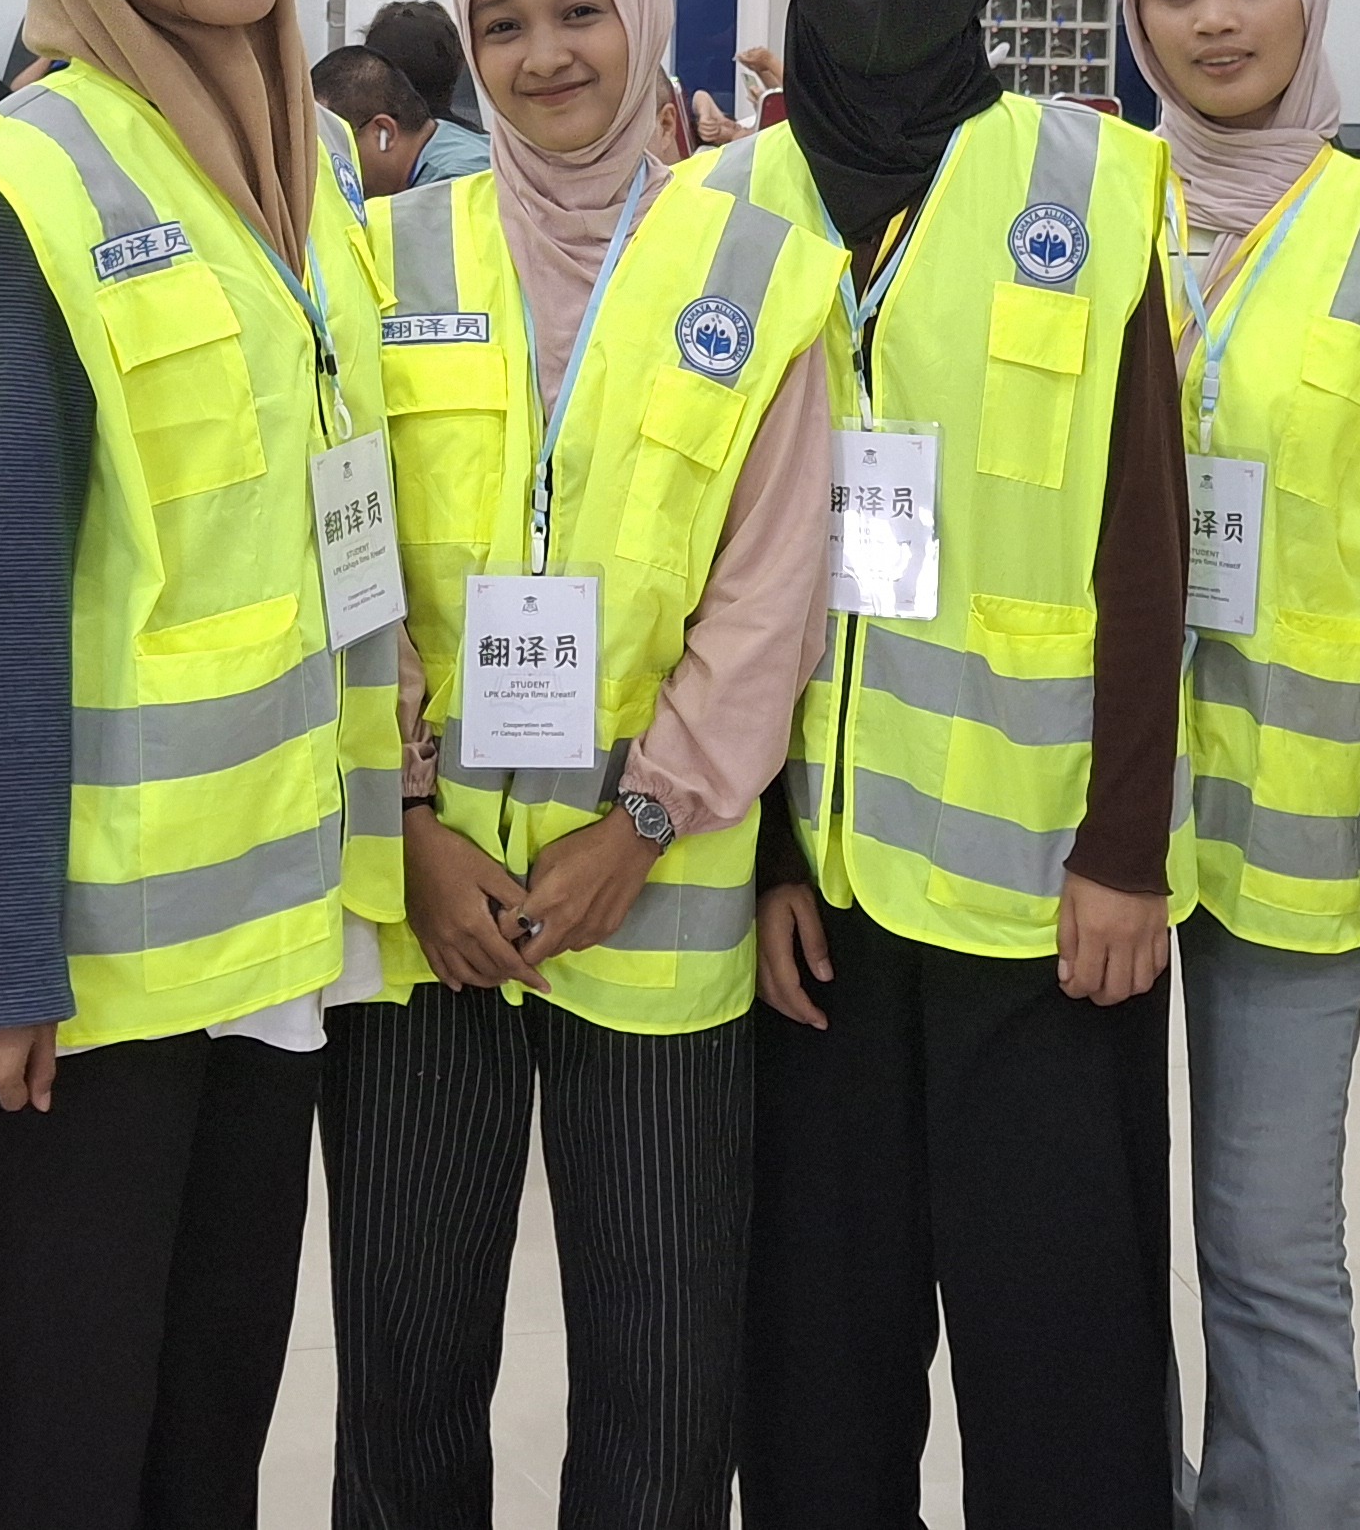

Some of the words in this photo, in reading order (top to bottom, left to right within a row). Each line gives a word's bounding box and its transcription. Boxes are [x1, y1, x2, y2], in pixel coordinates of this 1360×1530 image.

[1015, 211, 1040, 240] CAHAYA
[100, 227, 190, 272] 翻译员
[381, 318, 483, 339] 翻译员
[684, 303, 712, 328] CAHAYA
[324, 490, 383, 546] 翻译员
[1192, 509, 1243, 544] 译员
[1191, 548, 1219, 558] TUDENT
[478, 634, 578, 669] 翻译员
[501, 691, 529, 700] Cahaya
[551, 690, 576, 698] Kreatif
